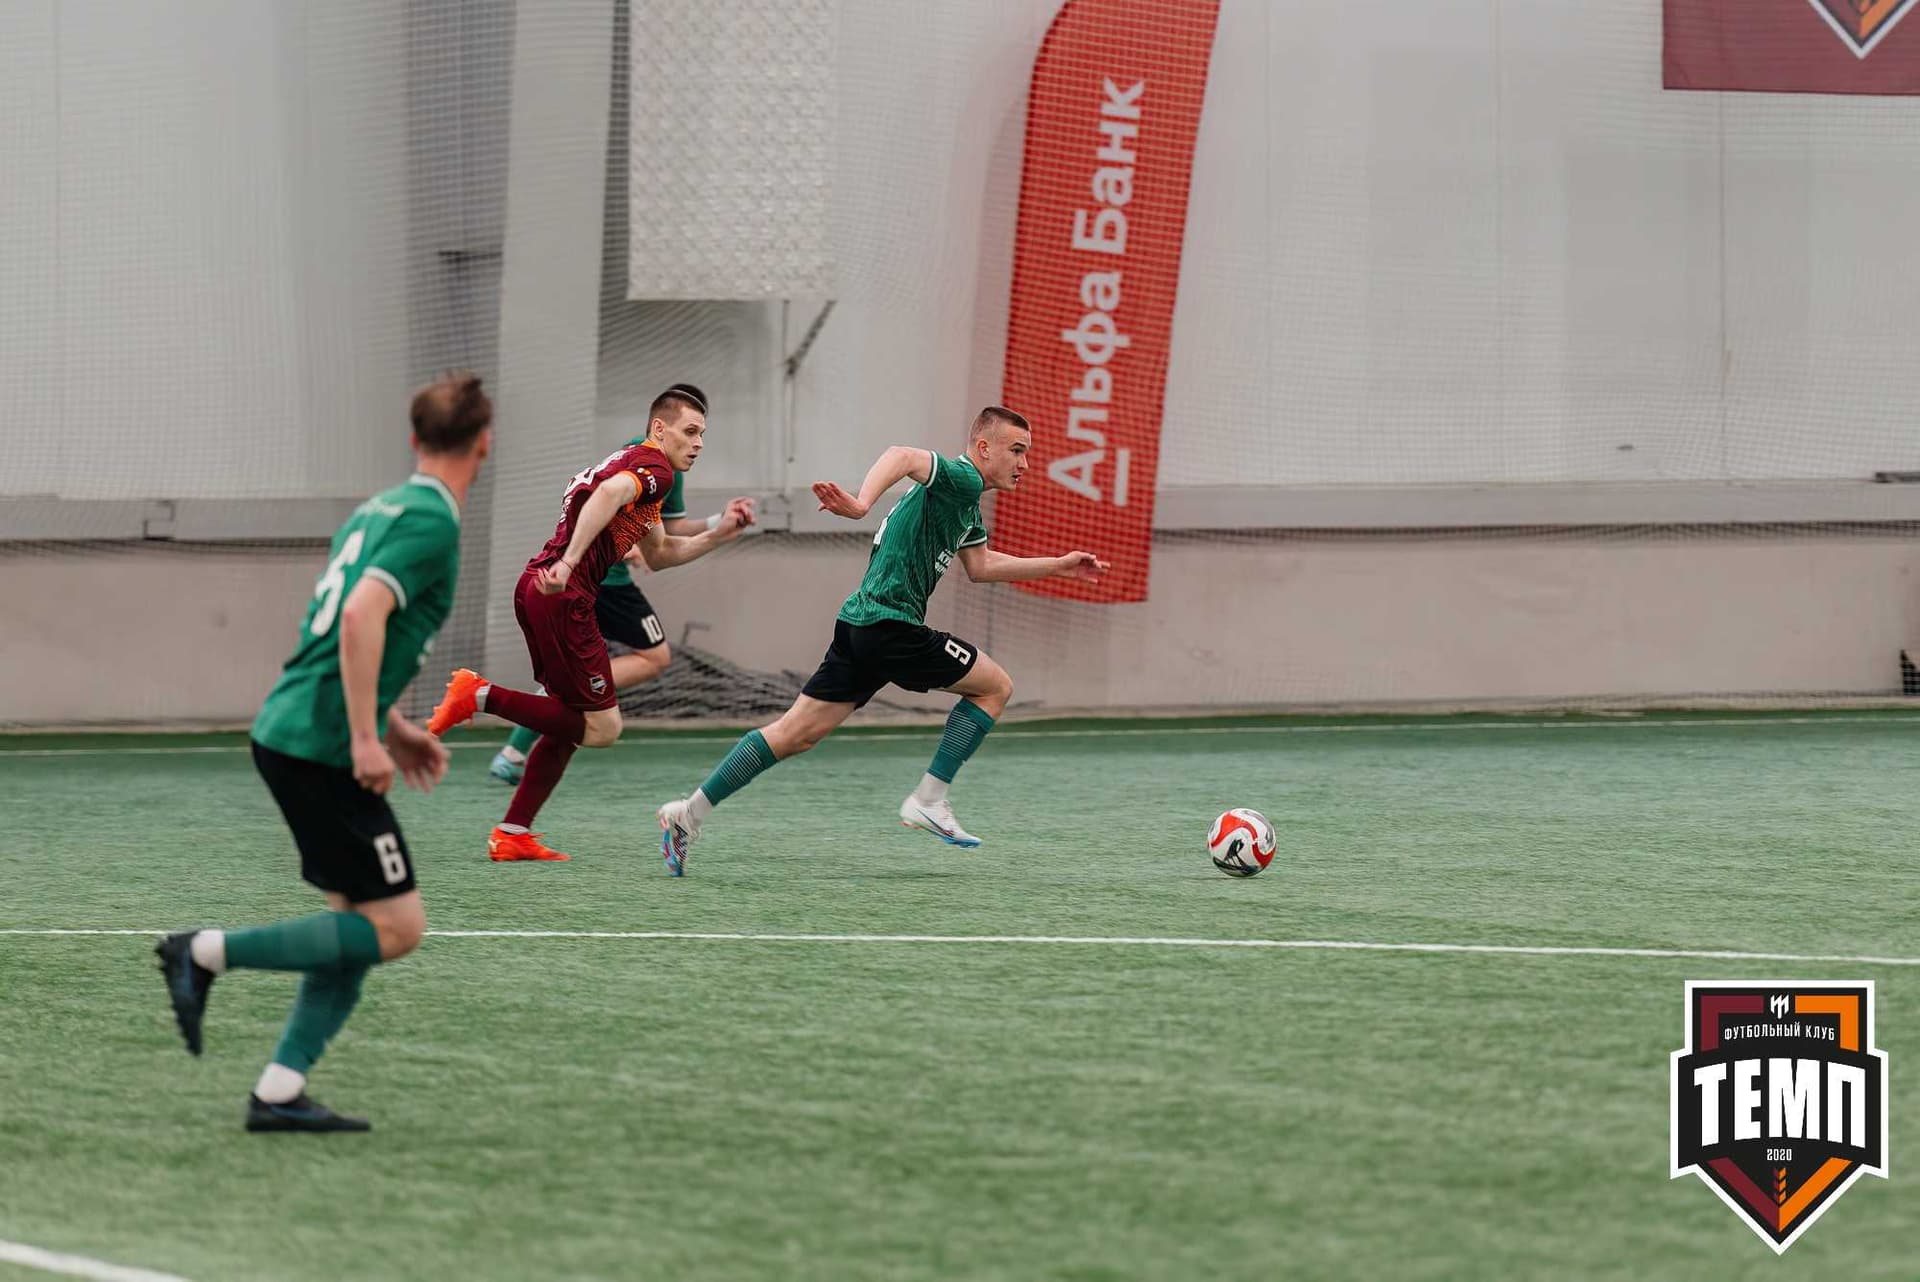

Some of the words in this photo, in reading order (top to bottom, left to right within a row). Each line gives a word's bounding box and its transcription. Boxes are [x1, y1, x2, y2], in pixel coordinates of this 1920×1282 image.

[1071, 76, 1146, 256] Банк
[1047, 271, 1131, 504] Альфа
[641, 614, 664, 644] 10
[944, 638, 972, 666] 9
[373, 831, 408, 886] 6
